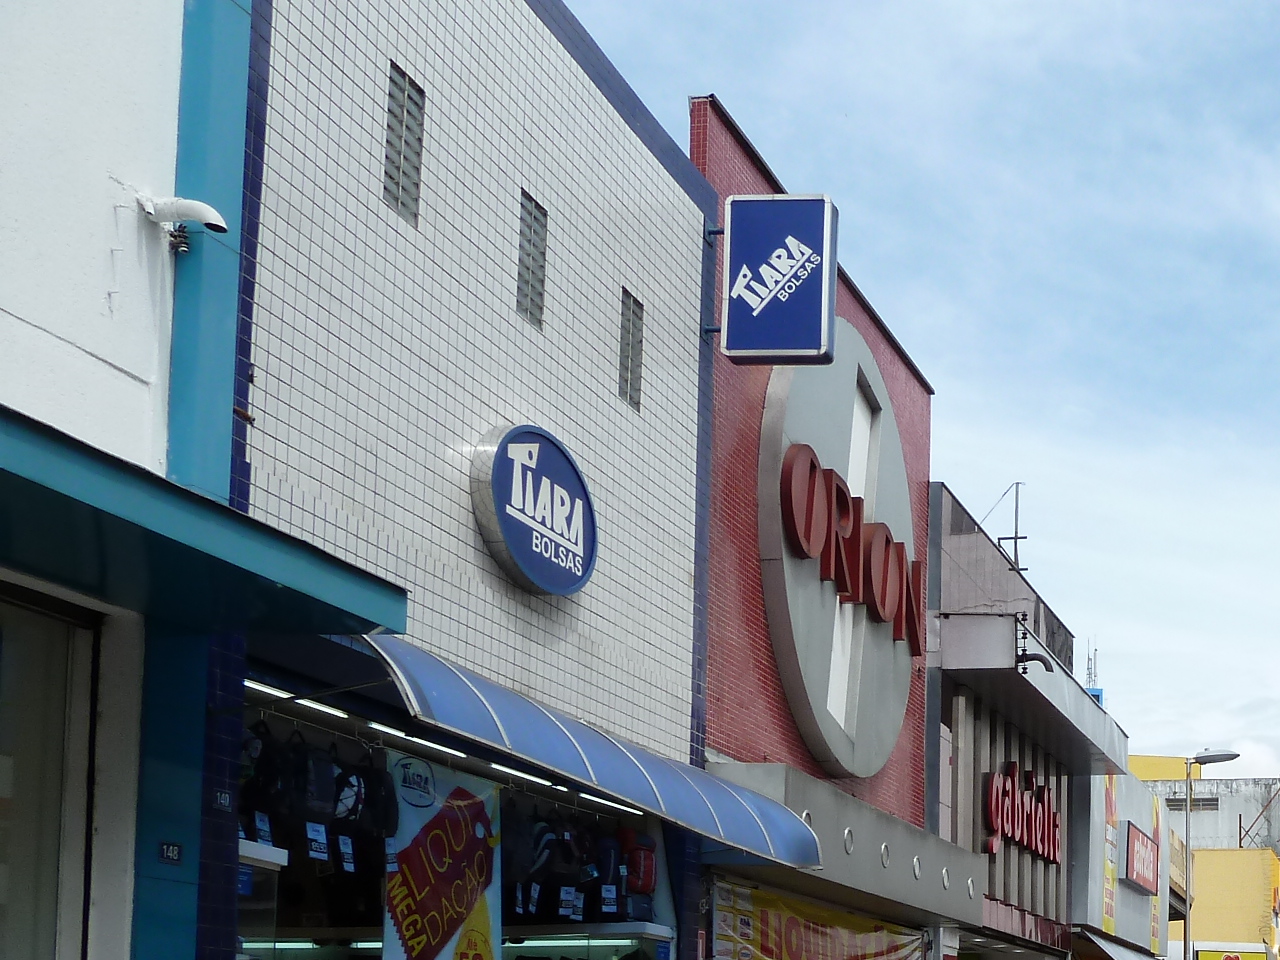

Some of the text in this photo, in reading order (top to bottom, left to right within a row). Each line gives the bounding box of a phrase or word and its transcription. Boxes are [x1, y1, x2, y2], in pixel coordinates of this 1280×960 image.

[730, 235, 813, 312] TIARA
[776, 253, 822, 302] BOLSAS
[507, 443, 584, 554] TIARA
[531, 531, 583, 577] BOLSAS
[781, 443, 922, 657] ORION
[162, 845, 179, 860] 148
[403, 799, 474, 902] LIQUI
[987, 761, 1061, 865] gabriella
[387, 873, 428, 958] MEGA
[424, 851, 487, 946] DAÇÃO
